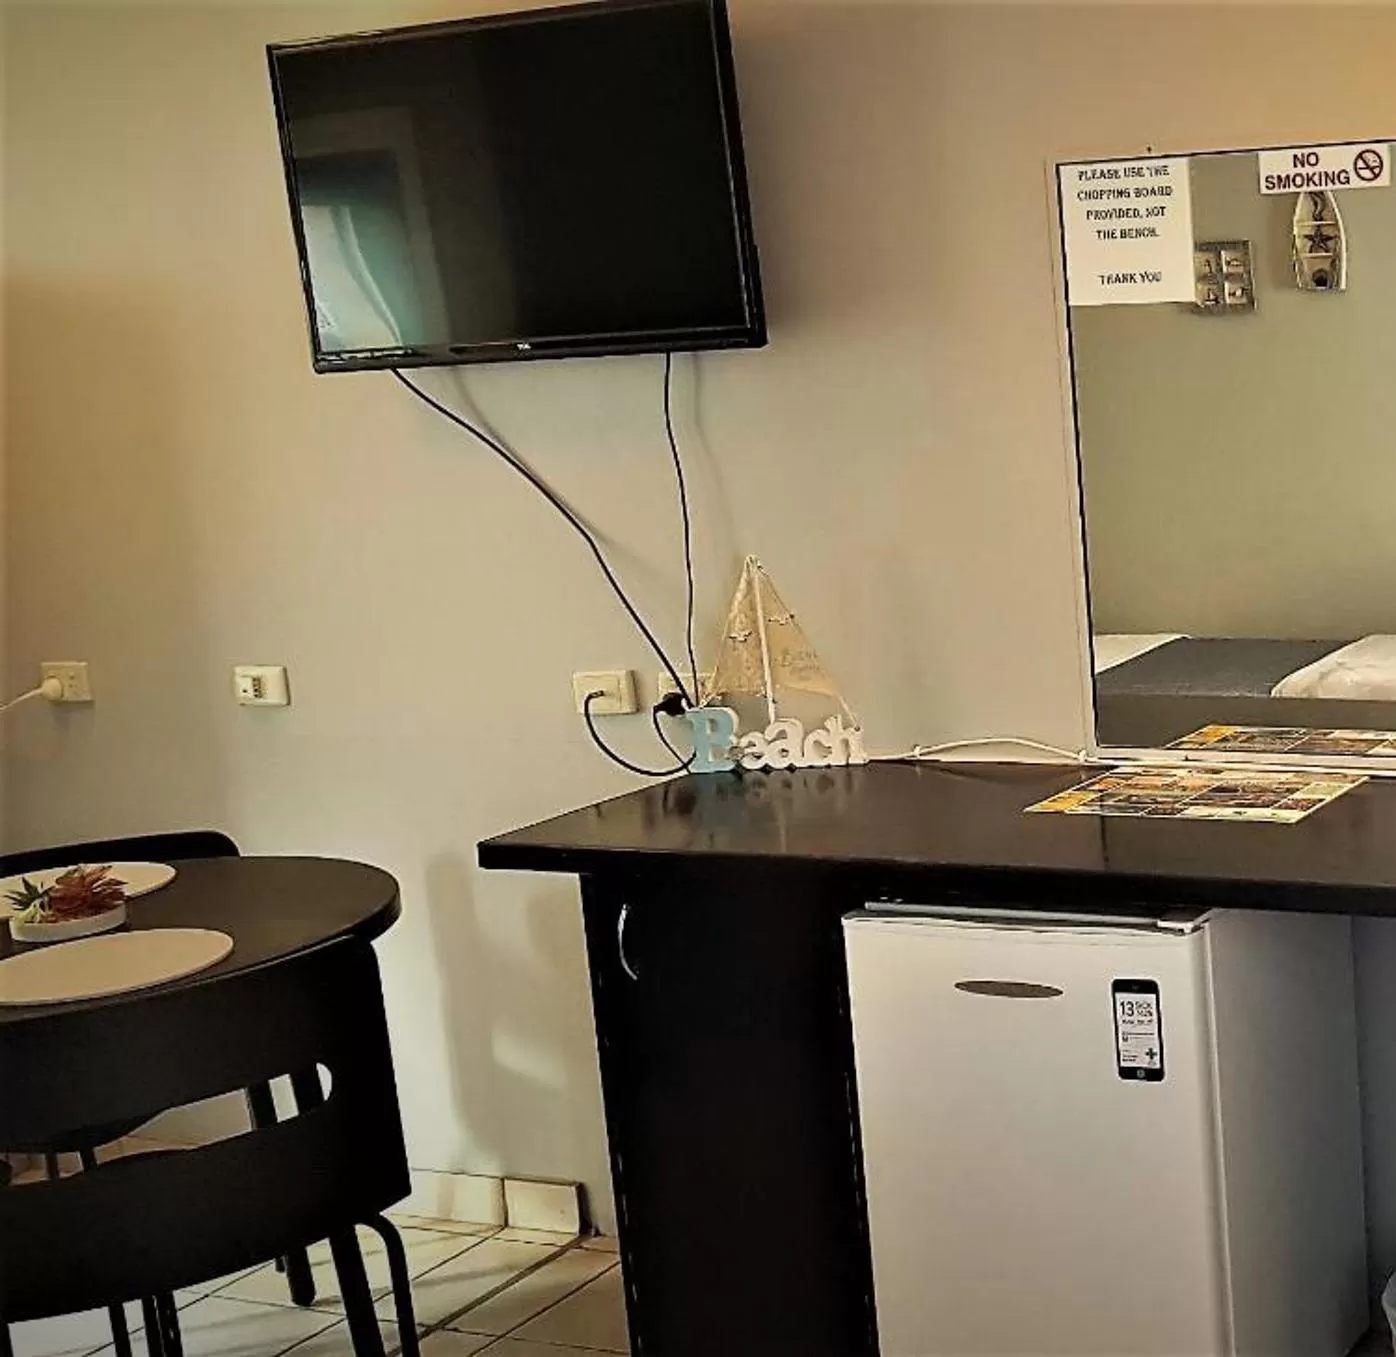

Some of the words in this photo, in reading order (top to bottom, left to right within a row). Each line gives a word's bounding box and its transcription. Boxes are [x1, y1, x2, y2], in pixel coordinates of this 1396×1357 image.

[1292, 152, 1319, 168] NO
[1078, 168, 1121, 181] PLEASE
[1123, 166, 1145, 178] USE
[1147, 165, 1170, 177] THE
[1264, 169, 1351, 190] SMOKING
[1077, 187, 1131, 201] CHOPPING
[1133, 185, 1174, 198] BOARD
[1145, 206, 1167, 218] NOT
[1096, 229, 1118, 240] THE
[1098, 272, 1137, 285] THANK
[1139, 271, 1162, 283] YOU
[685, 706, 870, 774] Beach
[1120, 1000, 1135, 1017] 13
